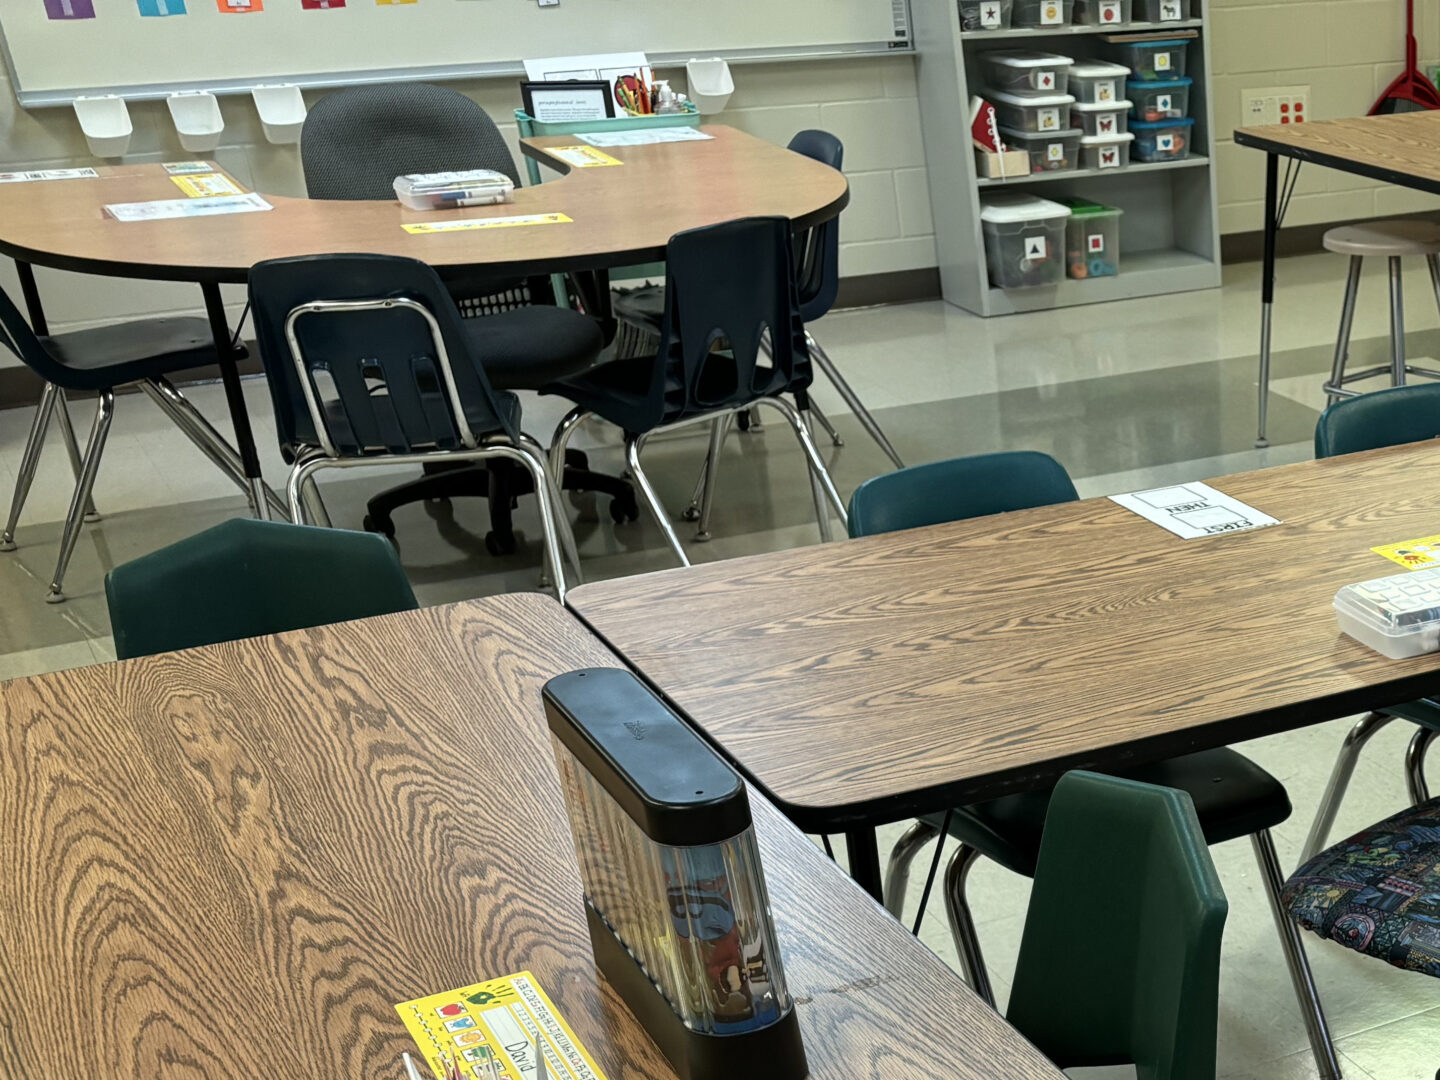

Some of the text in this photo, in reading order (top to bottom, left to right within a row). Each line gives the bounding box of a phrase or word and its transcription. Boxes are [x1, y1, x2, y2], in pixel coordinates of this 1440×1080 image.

[1165, 501, 1211, 514] THEN
[1203, 520, 1254, 534] FIRST
[504, 1040, 537, 1073] David
